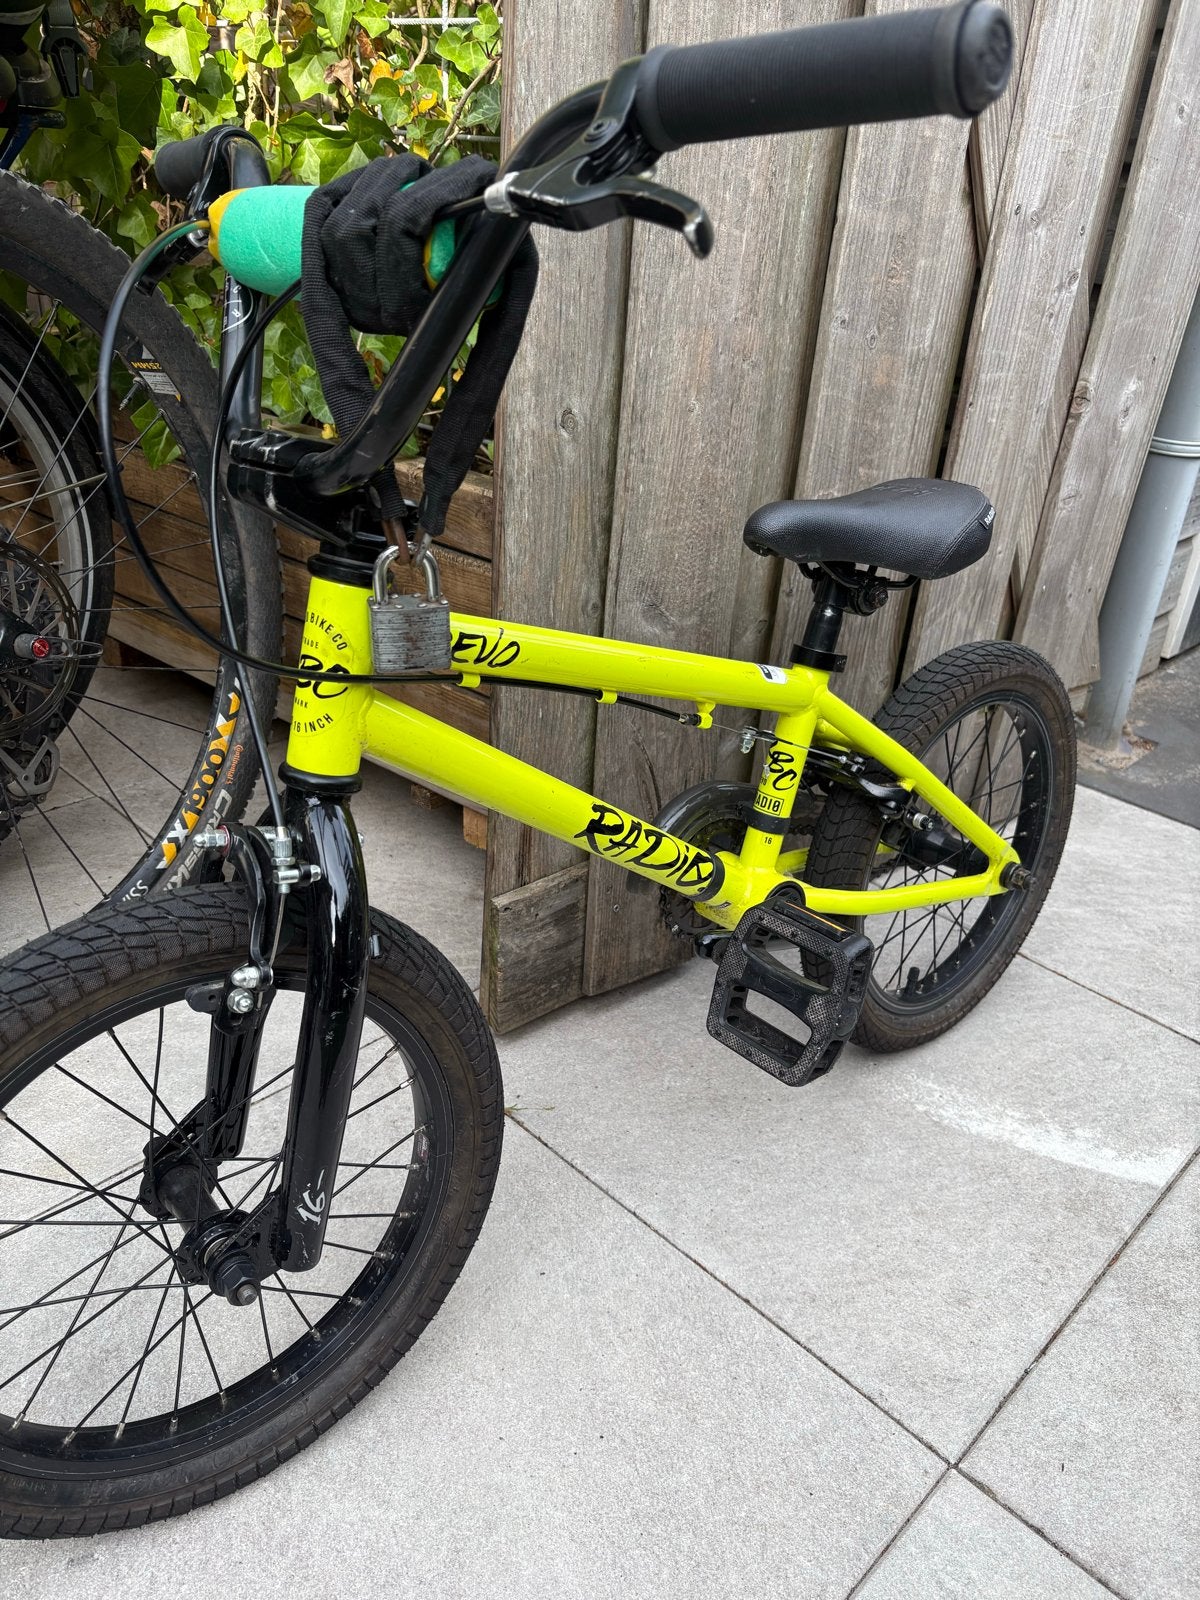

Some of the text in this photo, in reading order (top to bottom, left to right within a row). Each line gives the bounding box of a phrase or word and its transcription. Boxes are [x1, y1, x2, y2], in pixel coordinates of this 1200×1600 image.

[450, 627, 521, 669] EVO
[304, 713, 334, 733] INCH
[764, 836, 773, 846] 16
